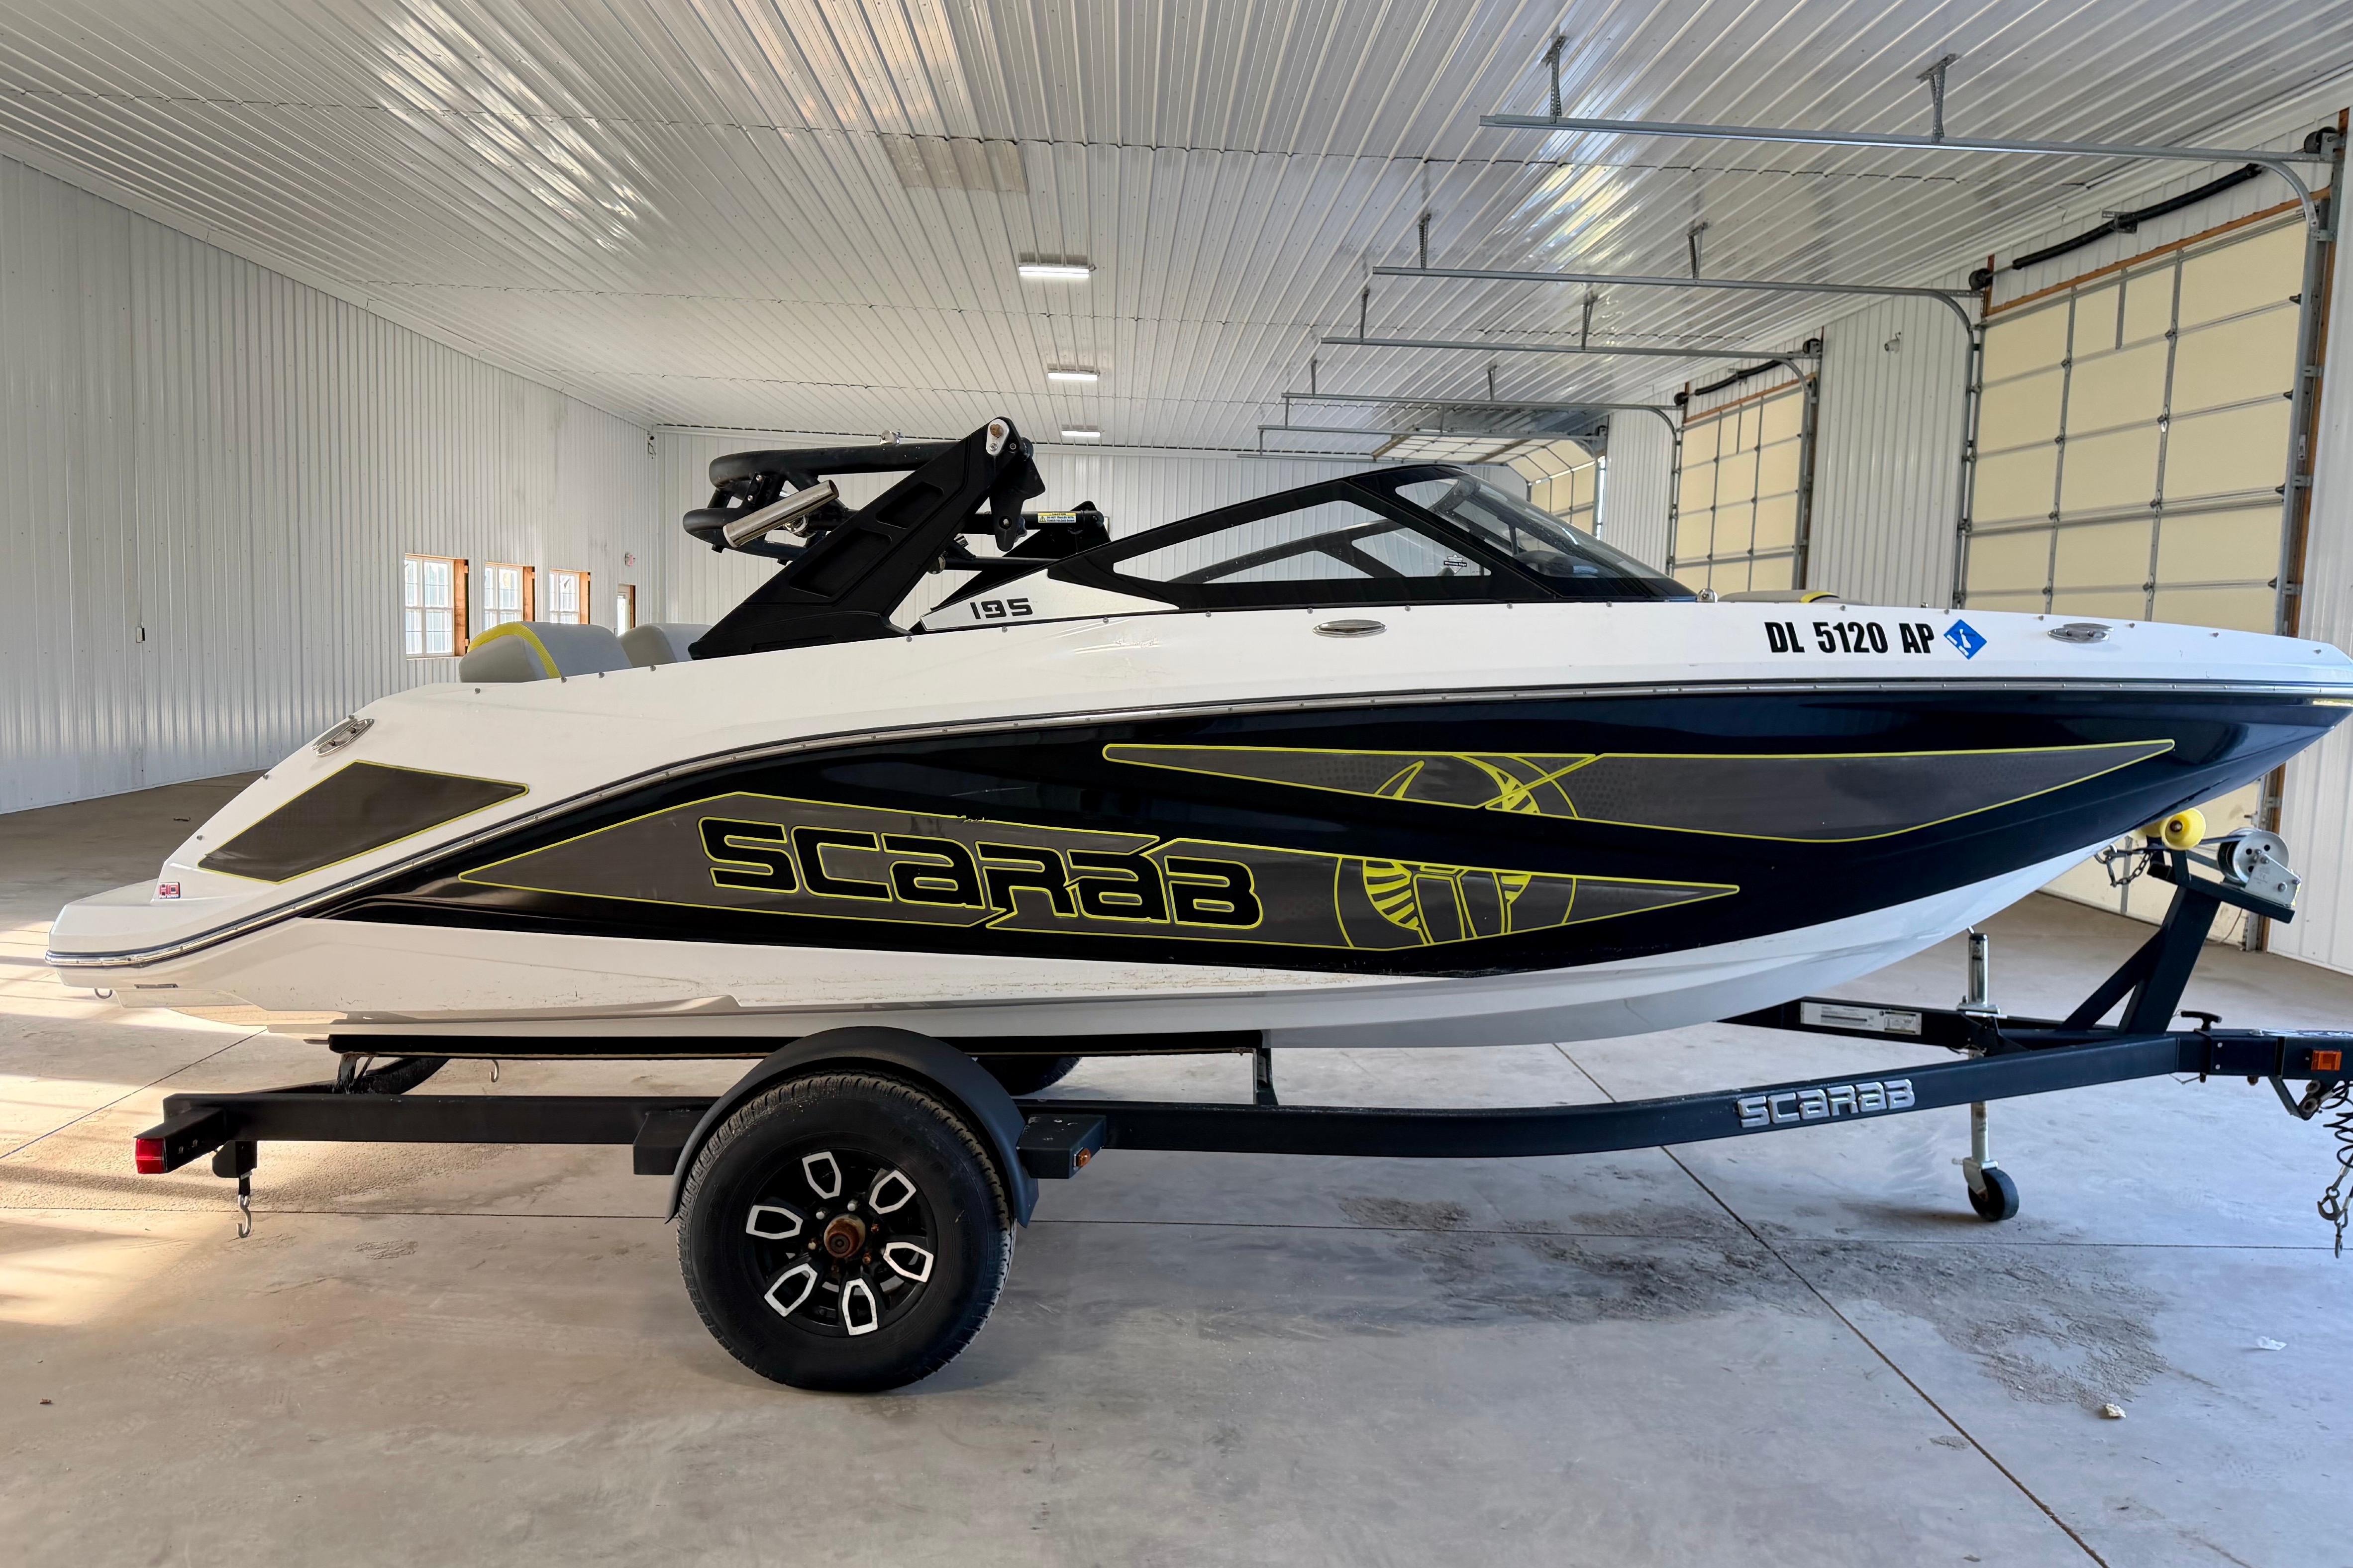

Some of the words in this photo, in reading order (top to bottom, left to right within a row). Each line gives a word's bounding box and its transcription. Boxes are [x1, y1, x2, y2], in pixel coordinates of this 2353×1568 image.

[970, 598, 1033, 619] 195
[1764, 622, 1805, 653] DL
[1812, 622, 1888, 653] 5120
[1898, 623, 1935, 653] AP
[698, 816, 1263, 929] SCARAB
[1737, 1078, 1915, 1128] SCARAB
